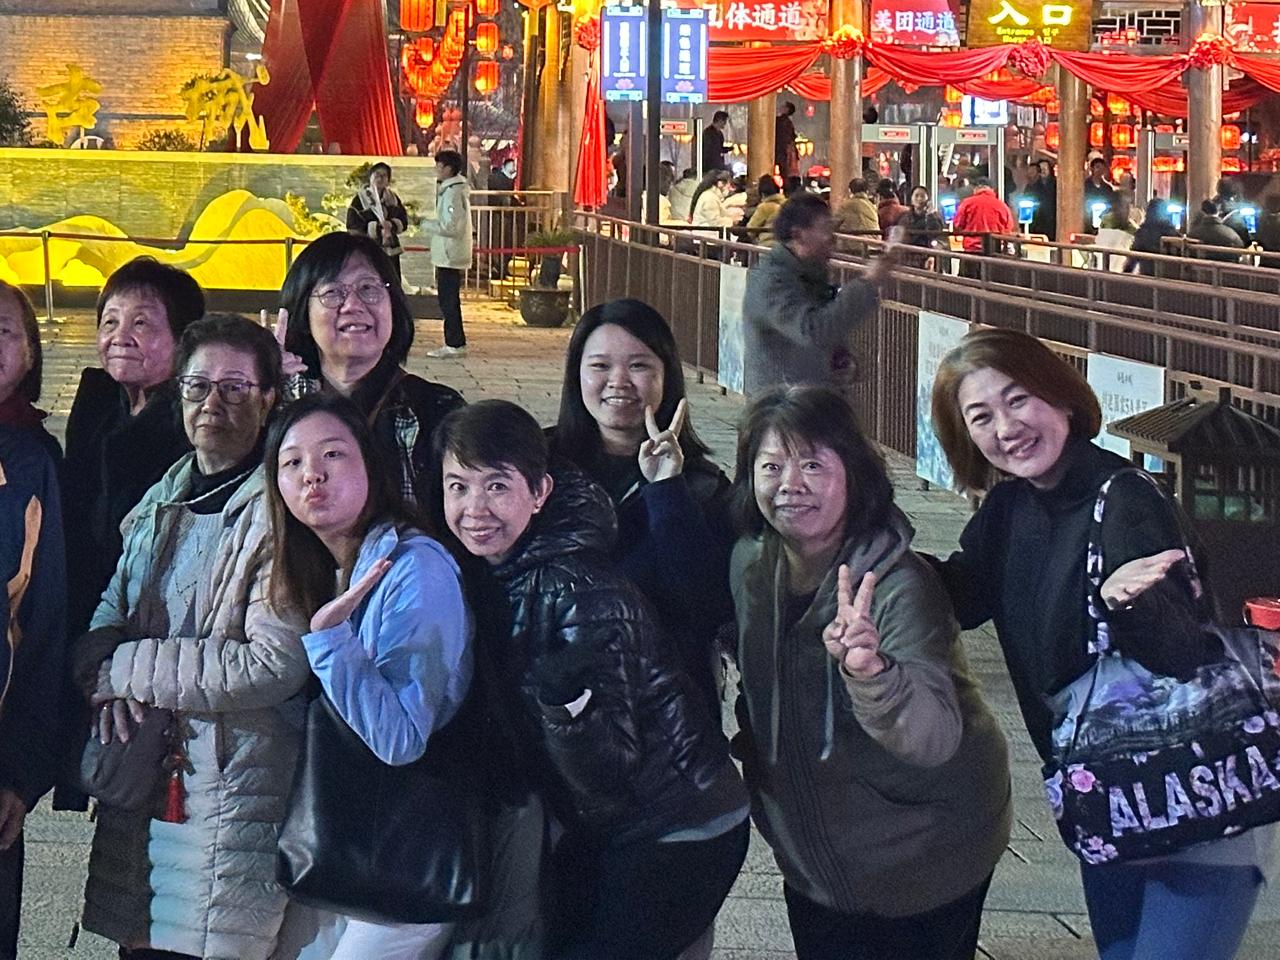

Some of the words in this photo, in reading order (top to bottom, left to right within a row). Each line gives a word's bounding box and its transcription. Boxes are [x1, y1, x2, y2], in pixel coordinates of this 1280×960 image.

[874, 9, 957, 35] 美团通道
[987, 0, 1073, 26] 入口
[1108, 744, 1280, 838] ALASKA
